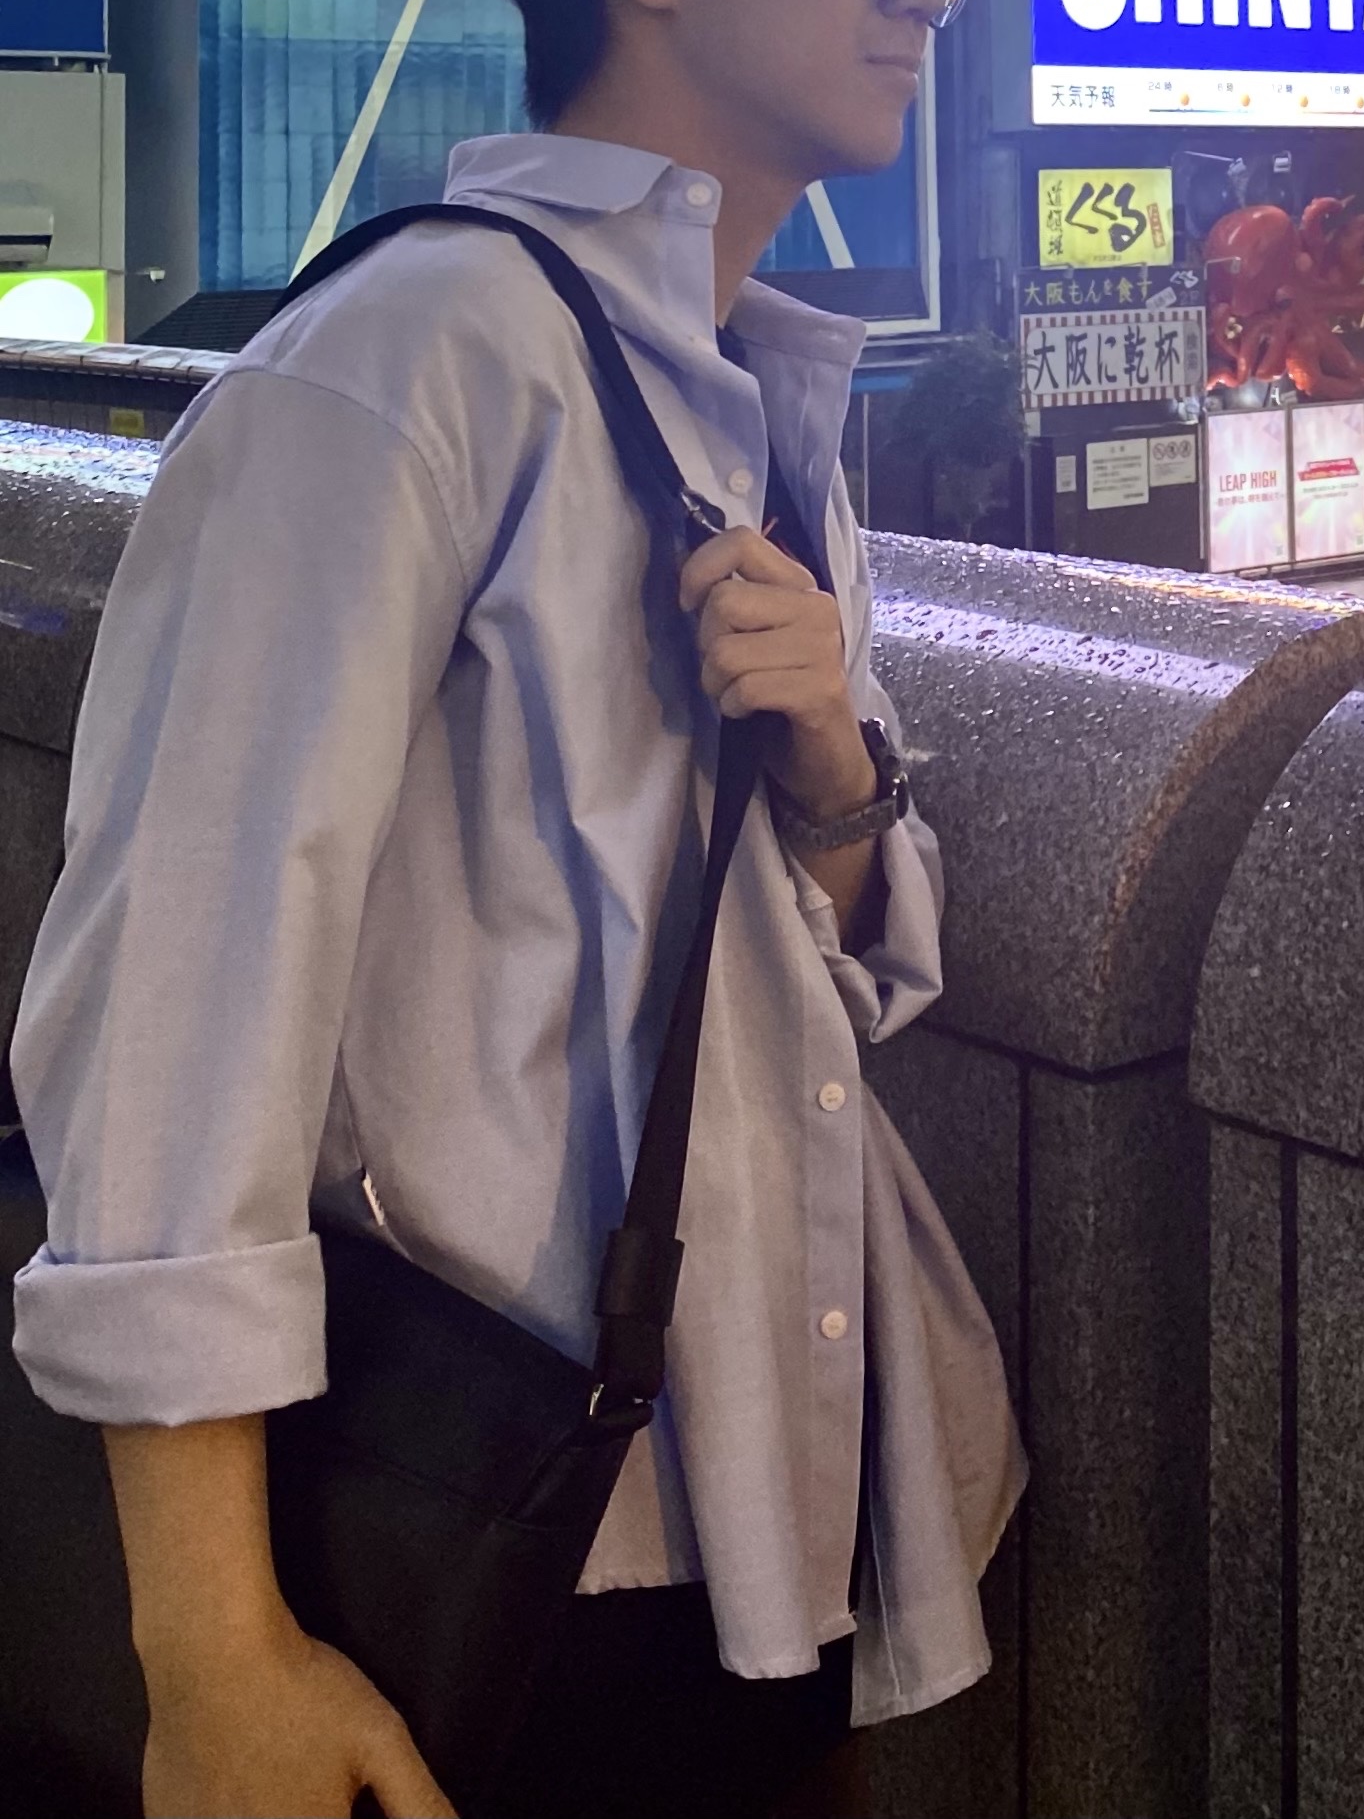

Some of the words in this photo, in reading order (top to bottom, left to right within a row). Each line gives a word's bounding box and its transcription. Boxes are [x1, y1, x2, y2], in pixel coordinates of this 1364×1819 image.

[1051, 84, 1116, 109] 天気予報
[1065, 181, 1147, 253] くくる
[1033, 325, 1180, 390] 大阪に乾杯
[1219, 473, 1247, 493] LEAP
[1250, 470, 1278, 488] HIGH
